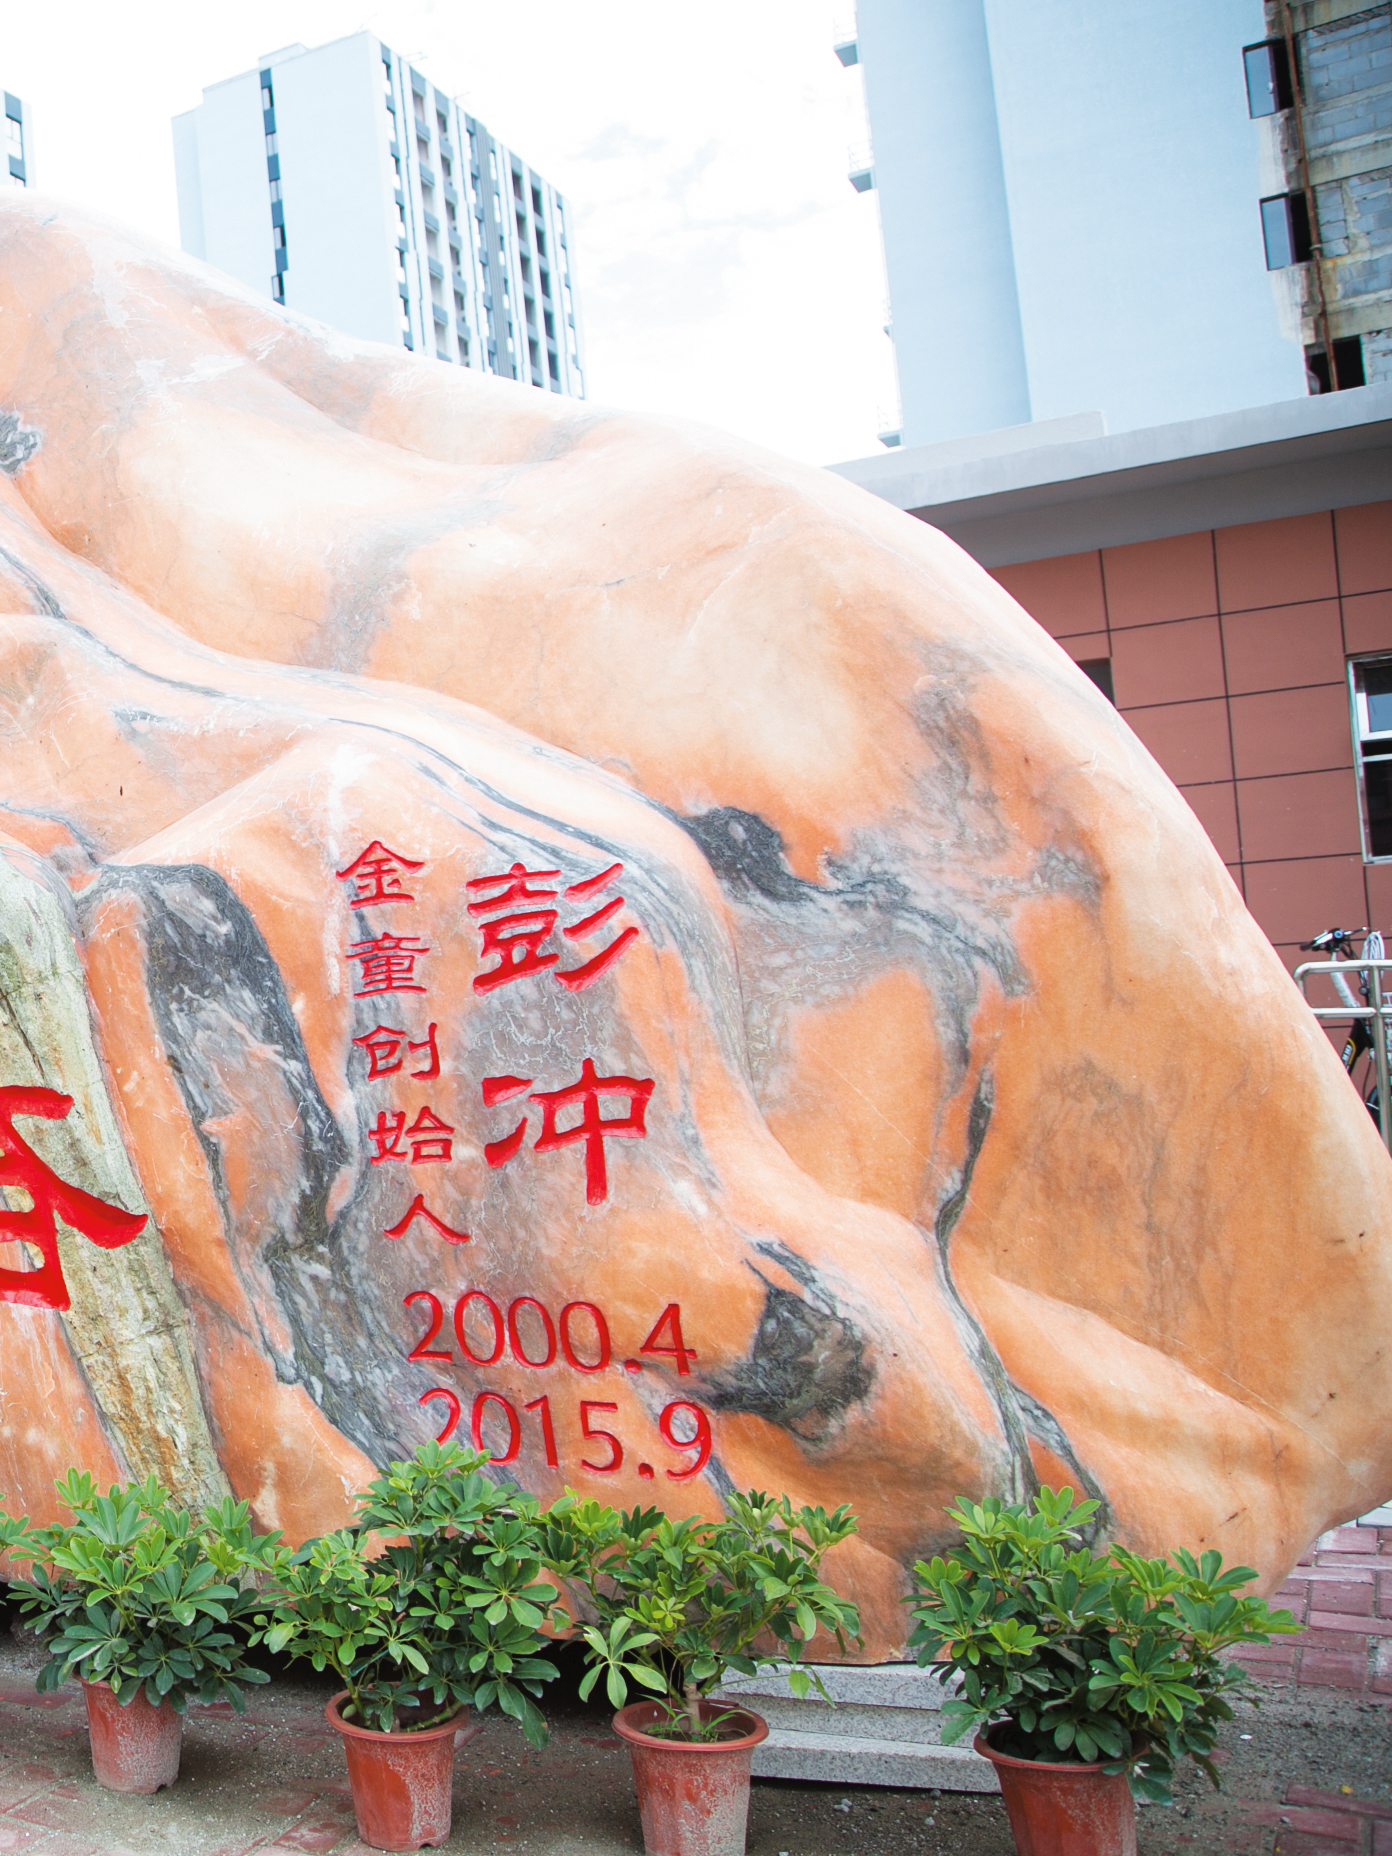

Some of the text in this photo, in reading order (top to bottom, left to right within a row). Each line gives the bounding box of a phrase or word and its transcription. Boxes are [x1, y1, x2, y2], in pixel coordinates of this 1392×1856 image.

[336, 840, 470, 1245] 金童创始人
[466, 862, 655, 1206] 彭冲
[403, 1290, 697, 1376] 2000.4
[418, 1387, 712, 1481] 2015.9
